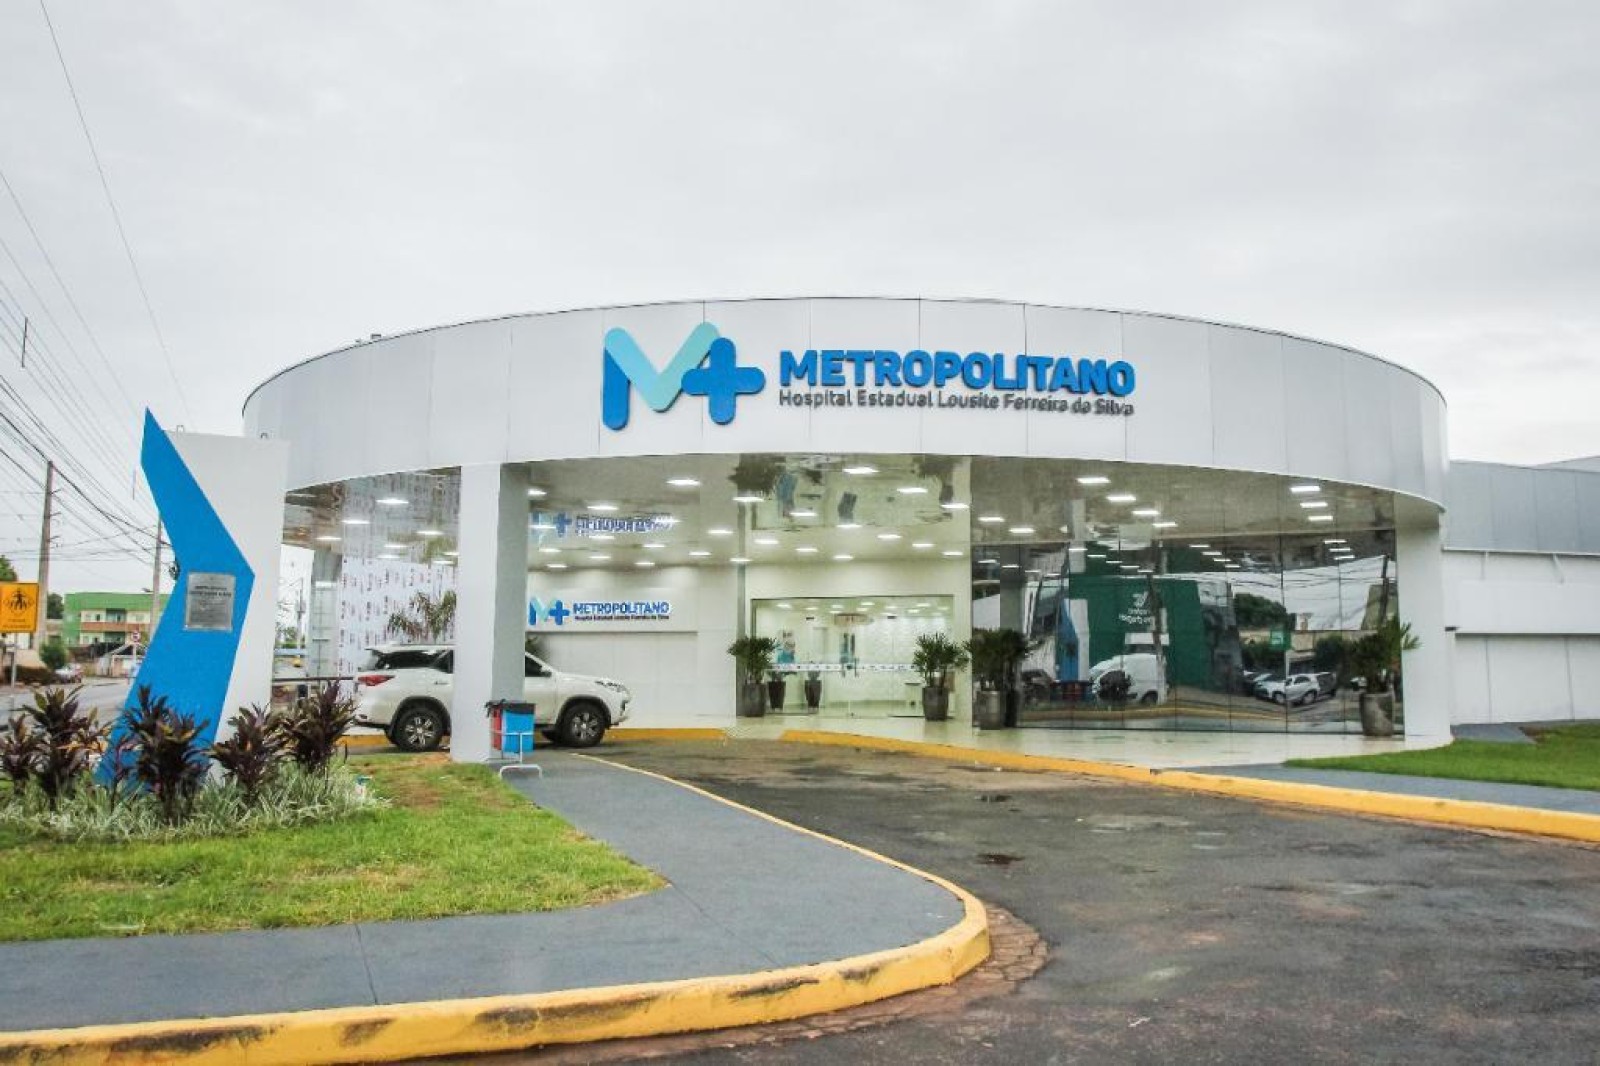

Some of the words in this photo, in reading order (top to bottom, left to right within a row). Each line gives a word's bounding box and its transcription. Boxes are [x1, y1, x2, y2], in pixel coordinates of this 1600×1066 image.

[779, 349, 1136, 398] METROPOLITANO
[779, 389, 853, 409] Hospital
[857, 389, 934, 408] Estadual
[937, 391, 1000, 409] Lousite
[1003, 394, 1068, 413] Ferreira
[1070, 397, 1091, 414] da
[1094, 399, 1135, 417] Silva
[573, 602, 669, 614] METROPOLITANO
